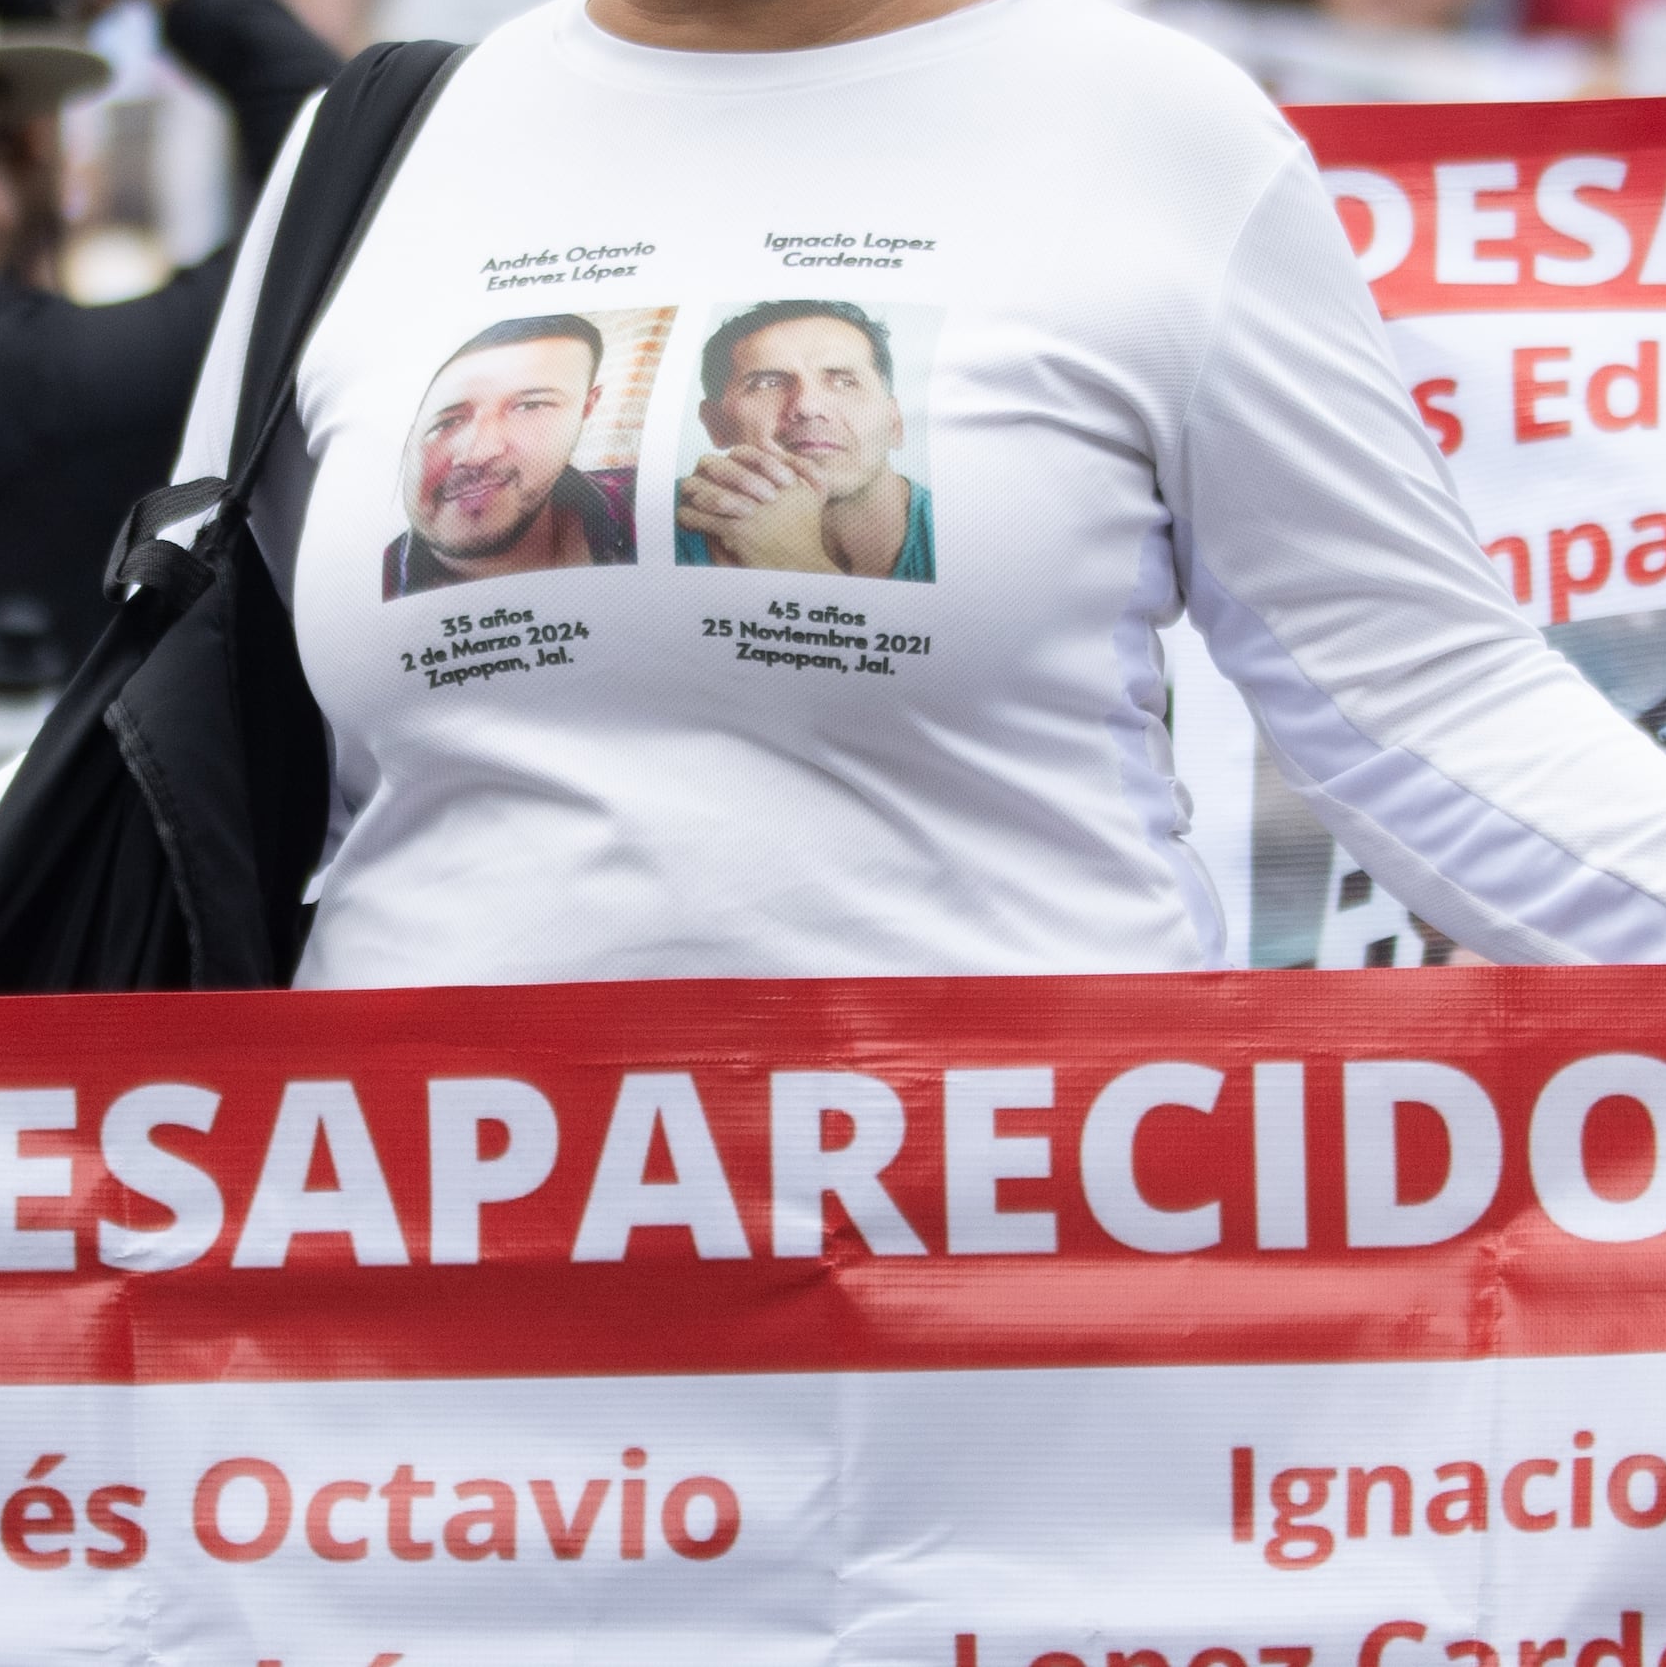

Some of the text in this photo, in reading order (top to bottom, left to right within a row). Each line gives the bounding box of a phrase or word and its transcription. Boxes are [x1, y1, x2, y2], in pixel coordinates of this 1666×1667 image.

[479, 242, 656, 274] Andrés Octavio
[764, 232, 937, 253] Ignacio Lopez
[782, 251, 904, 270] Cardenas
[486, 264, 637, 292] Estevez López
[441, 608, 535, 637] 35 años
[767, 600, 866, 627] 45 años
[400, 621, 590, 672] 2 de Marzo 2024
[702, 618, 932, 655] 25 Noviembre 2021
[424, 646, 575, 689] Zapopan, Jal.
[735, 642, 896, 676] Zapopan, Jal.
[192, 1446, 741, 1564] Octavio
